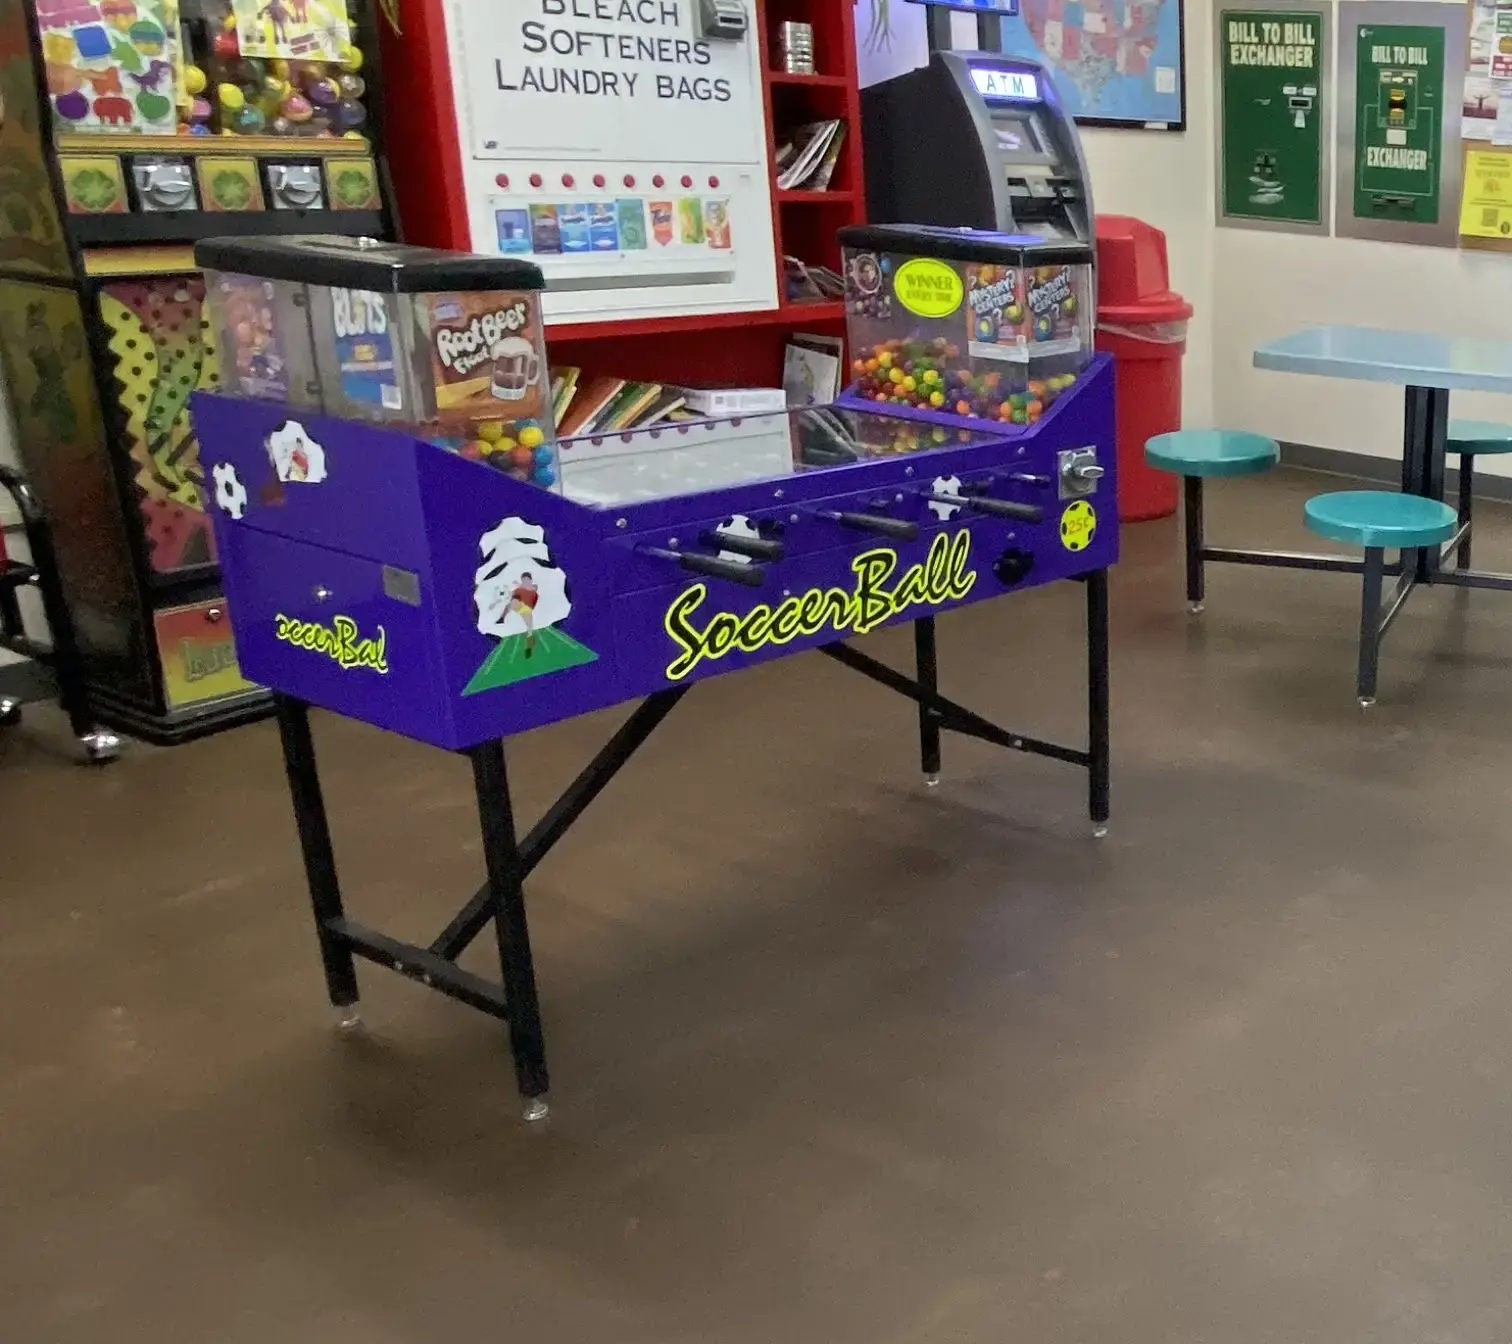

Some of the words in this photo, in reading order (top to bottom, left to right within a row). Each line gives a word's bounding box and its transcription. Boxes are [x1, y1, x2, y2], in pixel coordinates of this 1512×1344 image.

[521, 20, 711, 65] SOFTENERS
[1228, 21, 1259, 43] BILL
[1262, 22, 1281, 44] TO
[1284, 23, 1315, 45] BILL
[1230, 43, 1314, 68] EXCHANGER
[1372, 45, 1391, 63] BILL
[1393, 46, 1407, 64] TO
[1408, 47, 1428, 65] BILL
[495, 58, 639, 97] LAUNDRY
[657, 75, 732, 102] BAGS
[987, 74, 1024, 94] ATM
[1367, 146, 1427, 171] EXCHANGER
[905, 273, 953, 291] WINNER
